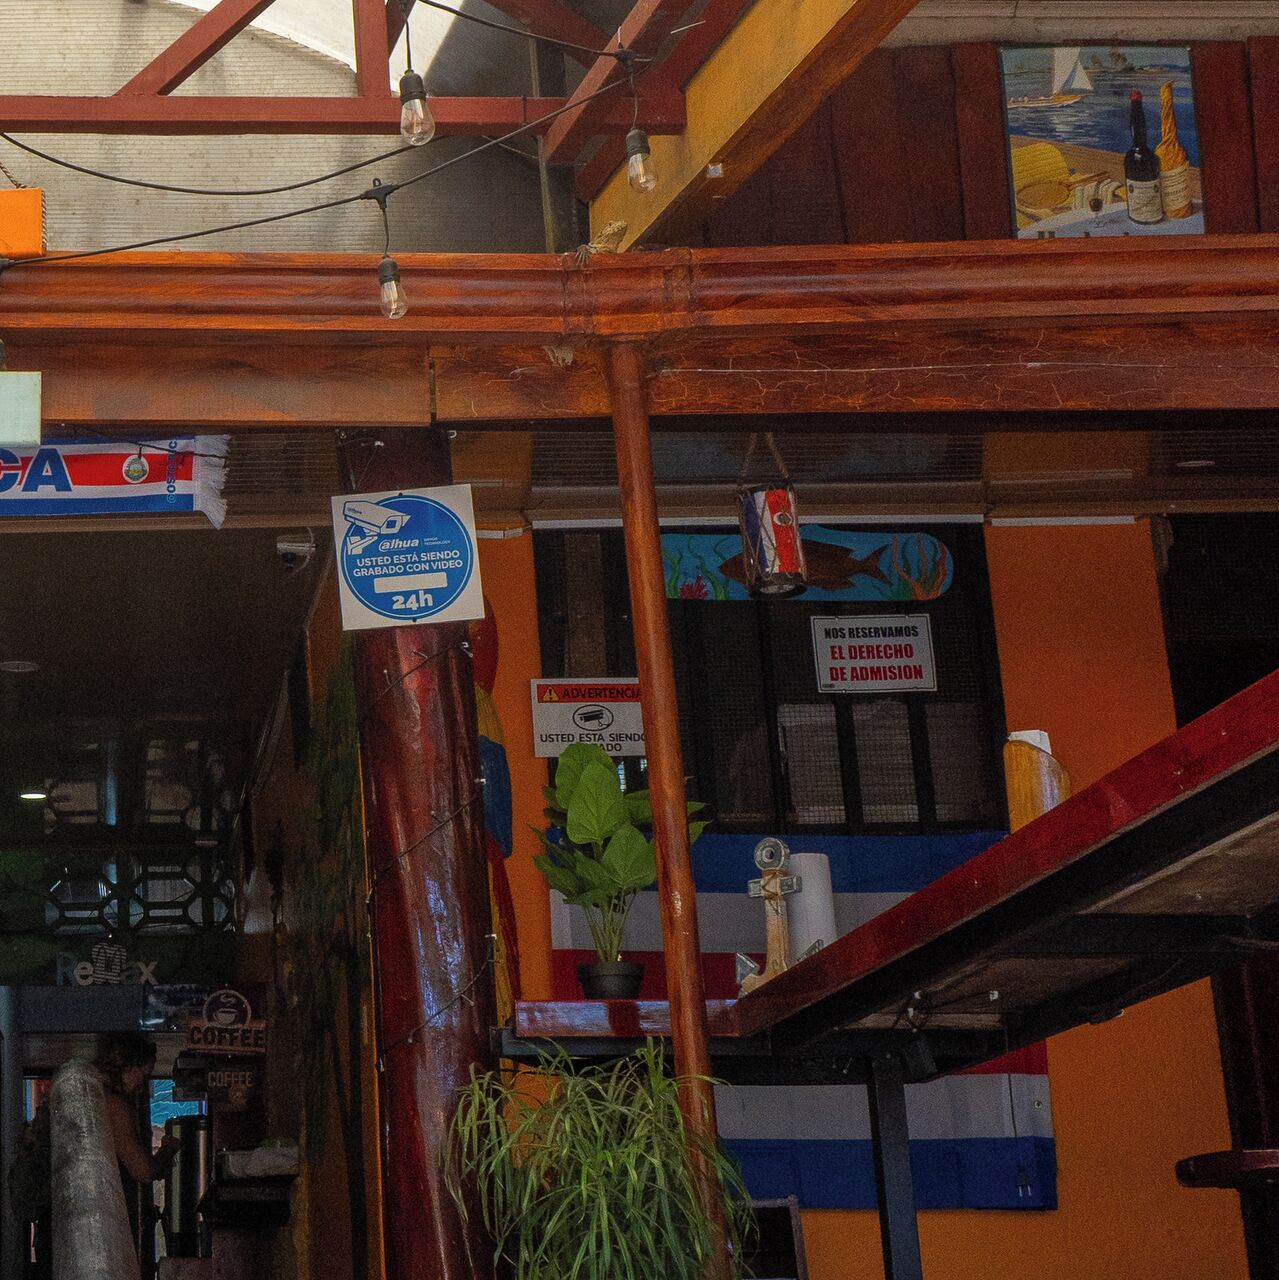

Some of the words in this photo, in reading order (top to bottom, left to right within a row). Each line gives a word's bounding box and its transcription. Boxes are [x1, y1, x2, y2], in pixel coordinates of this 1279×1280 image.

[356, 556, 391, 567] USTED
[393, 552, 419, 564] ESTÁ
[420, 550, 460, 561] SIENDO
[353, 565, 404, 577] GRABADO
[406, 562, 430, 572] CON
[432, 560, 464, 570] VIDEO
[391, 590, 434, 611] 24h
[824, 627, 846, 639] NOS
[848, 625, 919, 638] RESERVAMOS
[830, 645, 846, 660] EL
[848, 643, 914, 660] DERECHO
[829, 666, 848, 681] DE
[850, 664, 924, 681] ADMISION
[540, 733, 575, 743] USTED
[579, 733, 605, 742] ESTA
[190, 1026, 265, 1047] COFFEE
